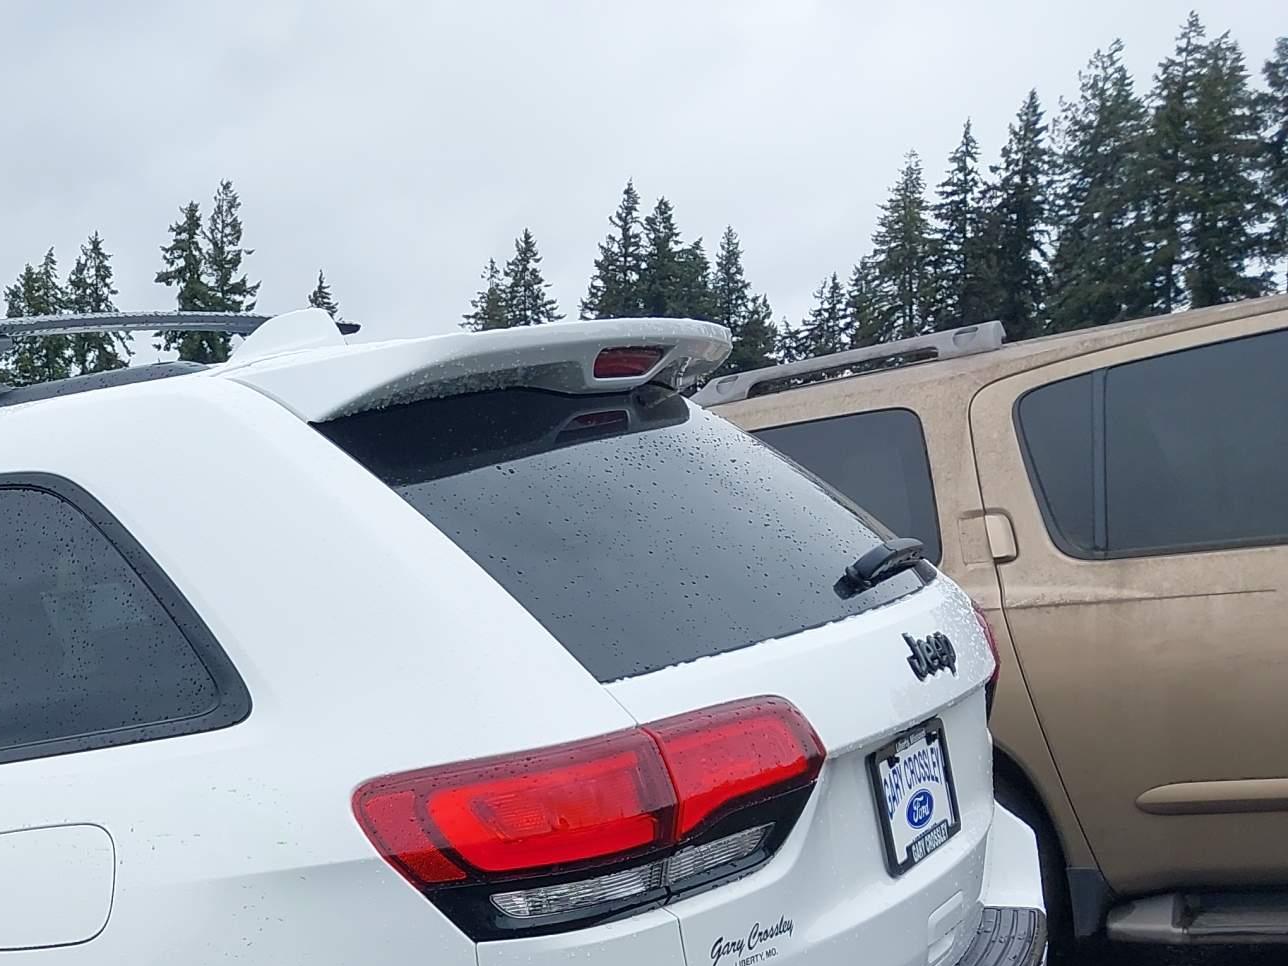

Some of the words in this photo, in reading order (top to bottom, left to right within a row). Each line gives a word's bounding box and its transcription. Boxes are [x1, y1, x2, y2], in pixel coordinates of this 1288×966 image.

[901, 631, 957, 681] Jeep
[882, 764, 905, 821] GARY
[903, 746, 943, 790] CROSSLEY
[912, 796, 930, 823] Ford
[747, 914, 793, 950] Crossley
